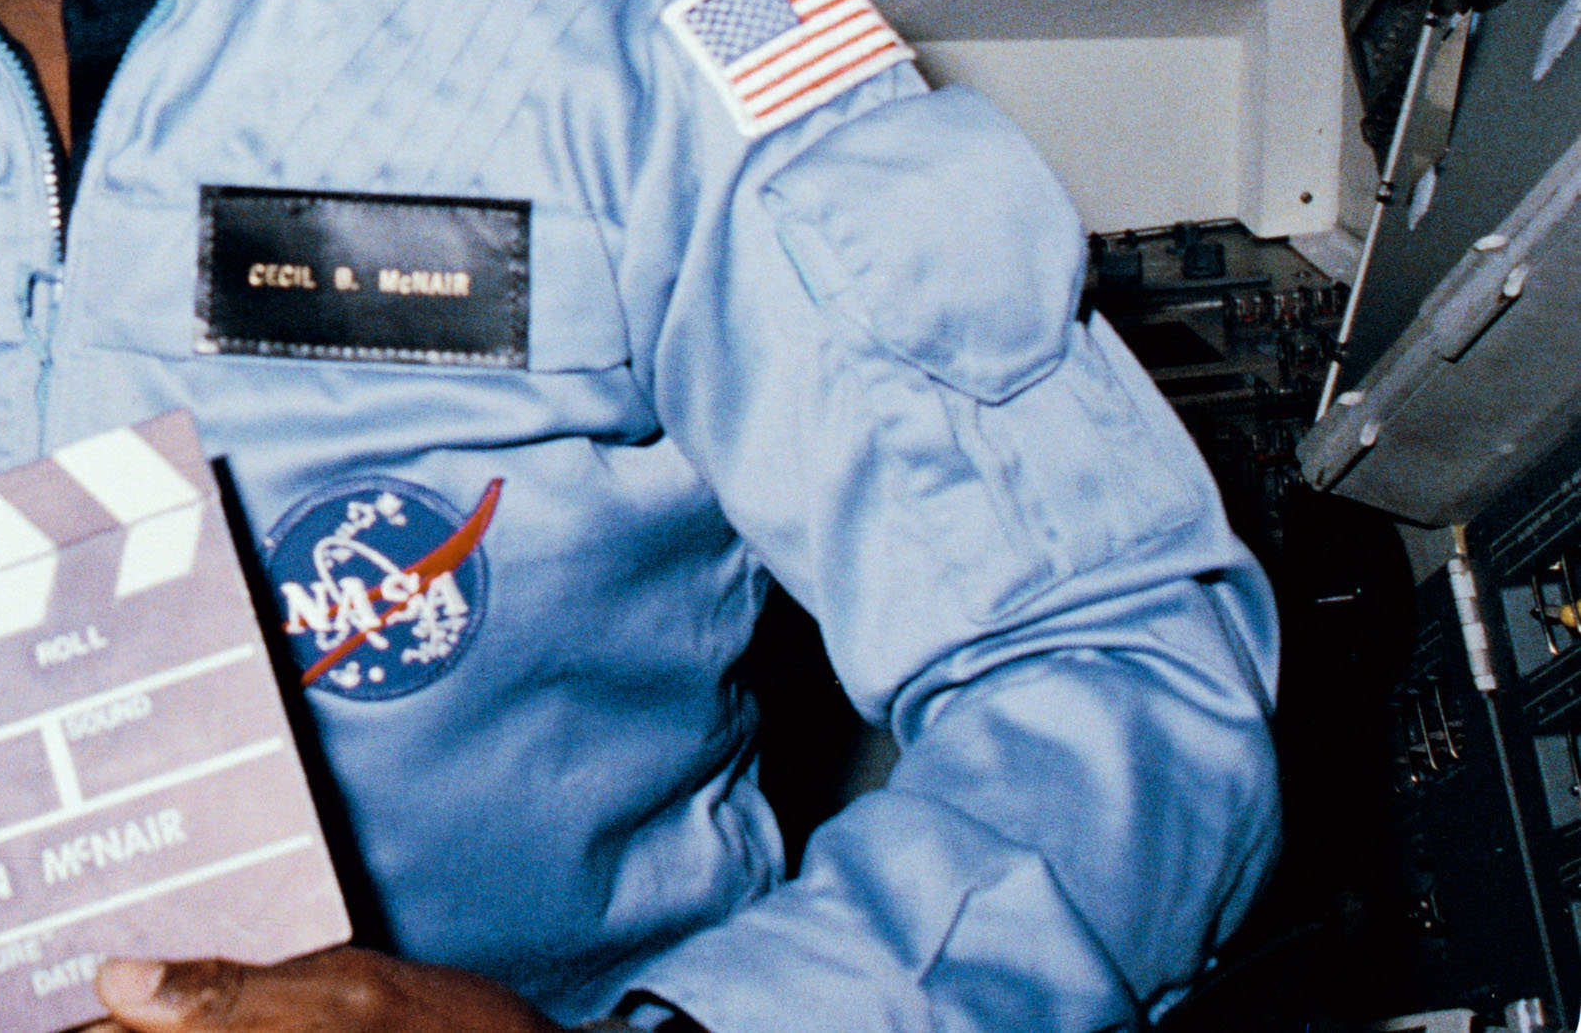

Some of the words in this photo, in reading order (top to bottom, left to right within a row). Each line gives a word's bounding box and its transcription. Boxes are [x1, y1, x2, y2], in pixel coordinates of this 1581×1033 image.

[247, 262, 317, 291] CECIL
[377, 270, 471, 298] McNAIR
[281, 574, 469, 637] NASA
[35, 624, 109, 667] ROLL
[69, 691, 153, 741] SOUND
